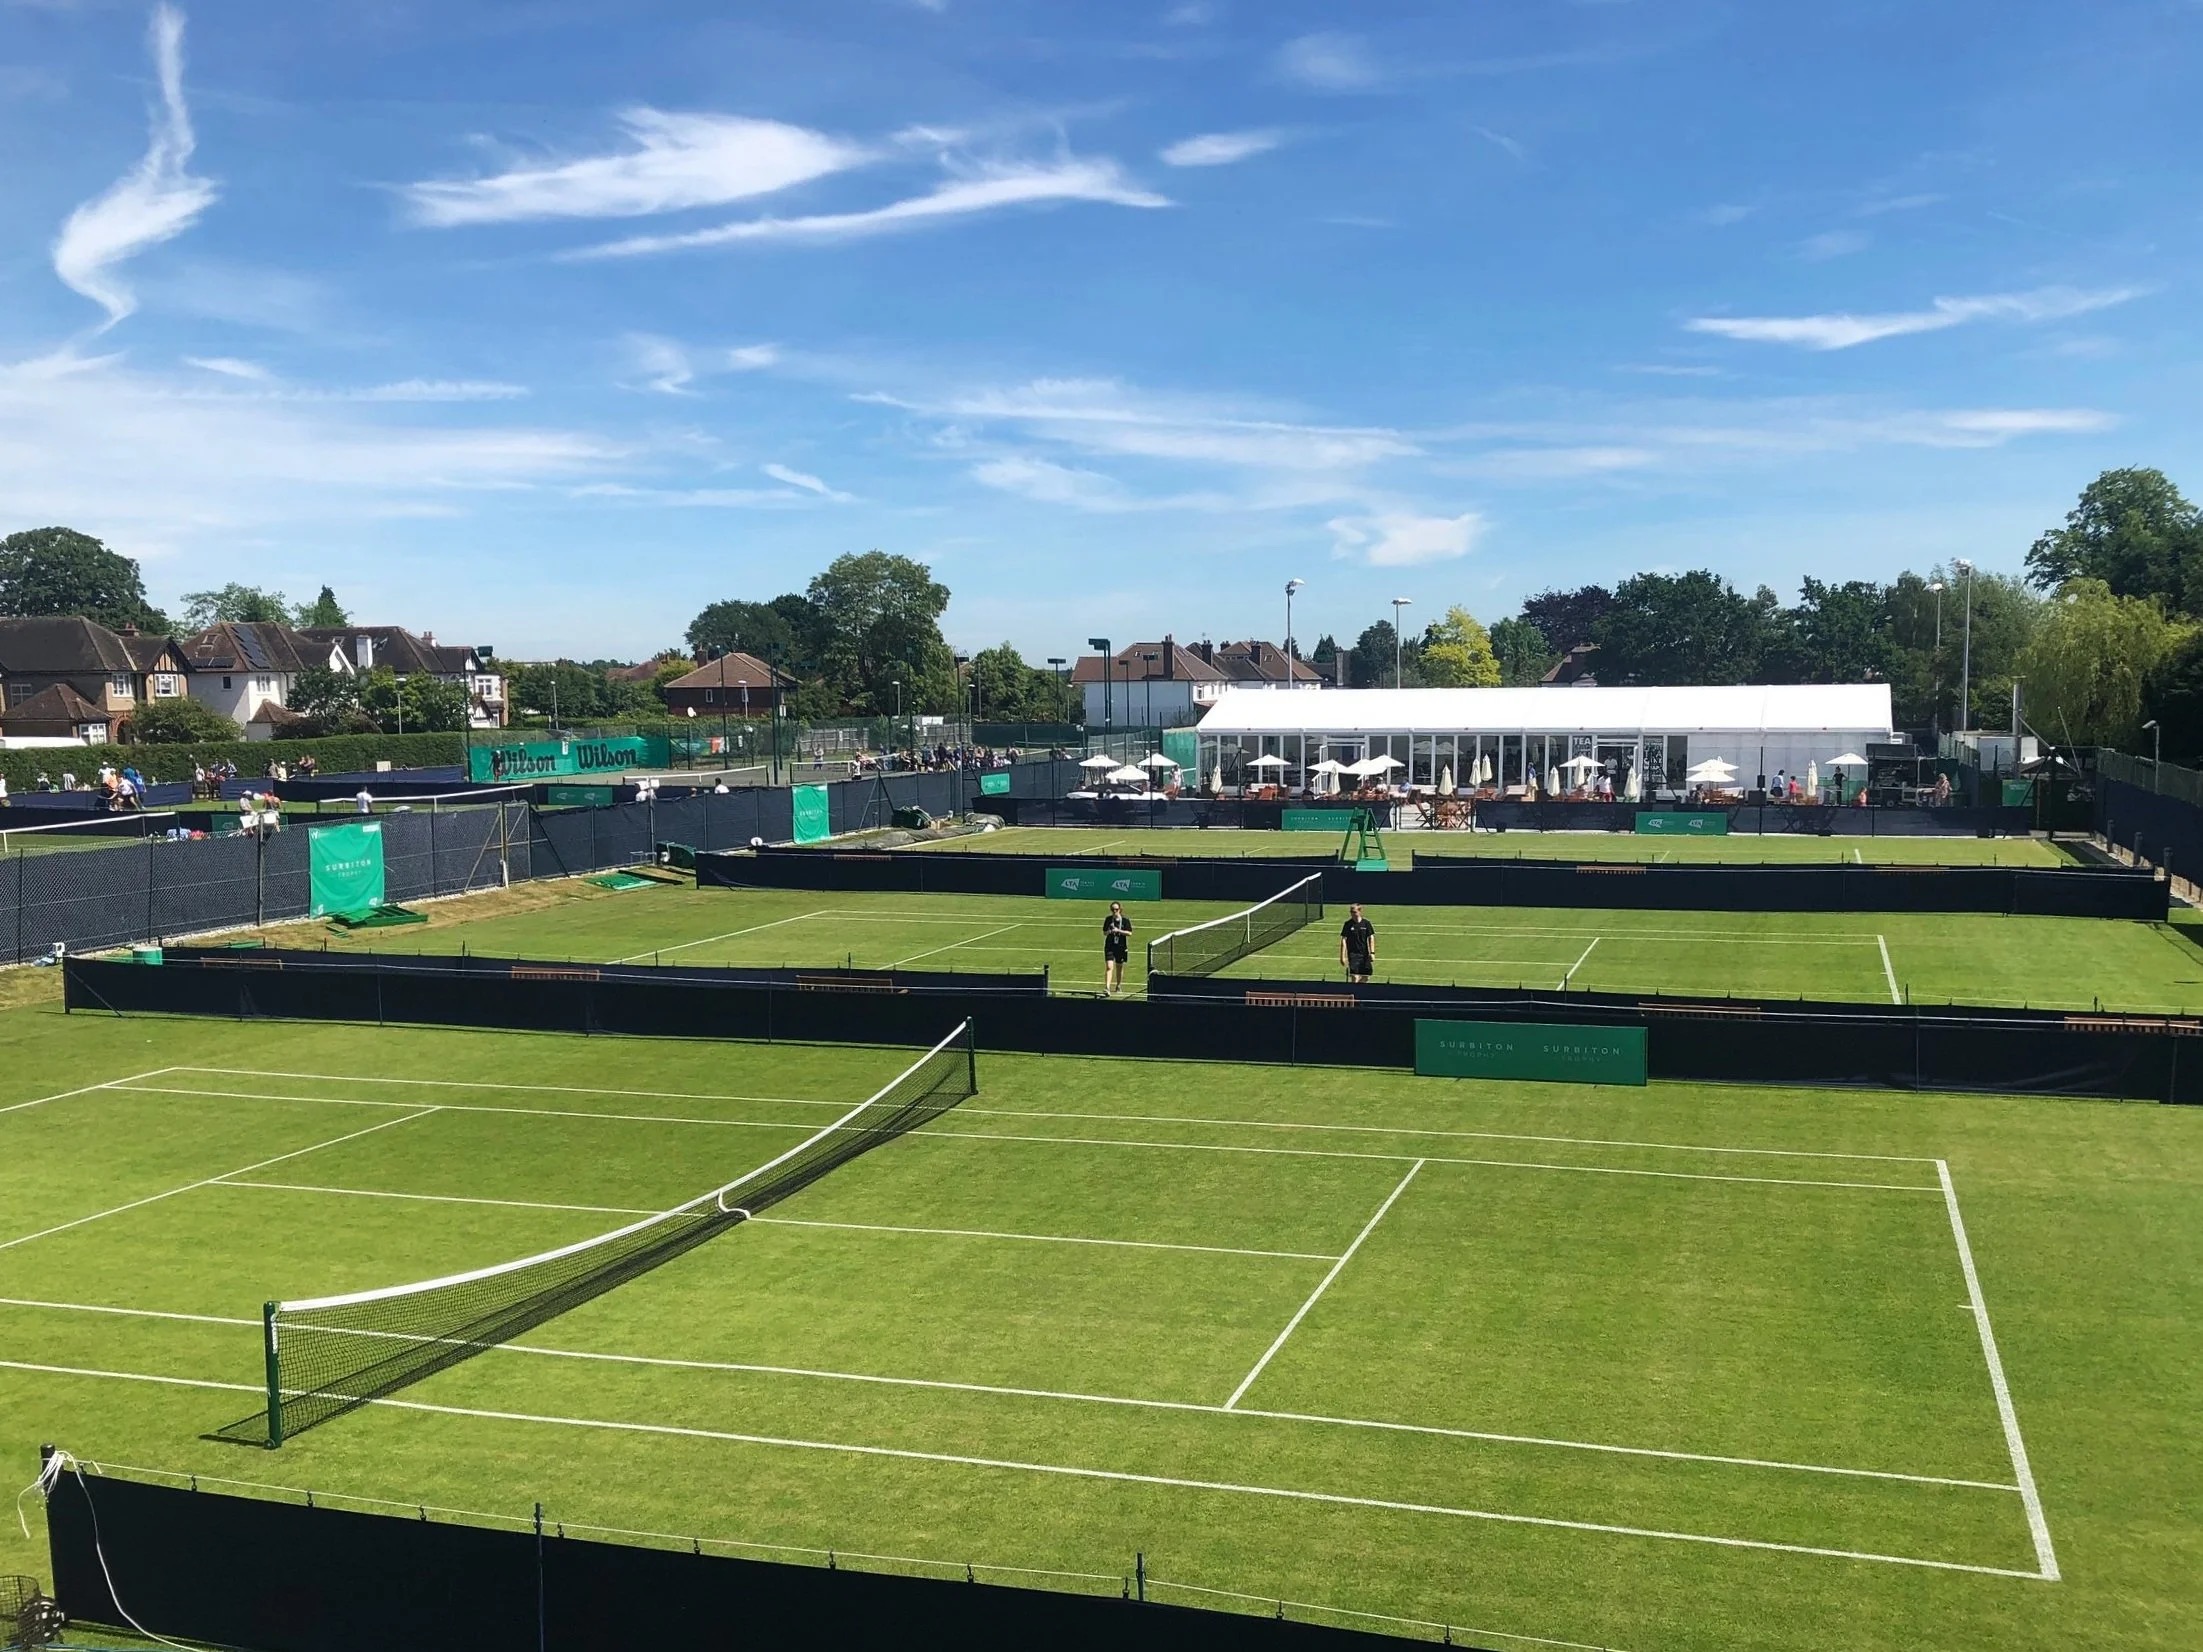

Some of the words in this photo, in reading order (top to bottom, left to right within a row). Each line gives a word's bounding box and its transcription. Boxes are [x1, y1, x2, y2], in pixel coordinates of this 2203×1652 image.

[1573, 737, 1591, 745] TEA
[577, 743, 637, 769] Wilson
[325, 859, 371, 871] SURBITON
[1440, 1040, 1514, 1051] SURBITON
[1543, 1045, 1620, 1056] SURBITON
